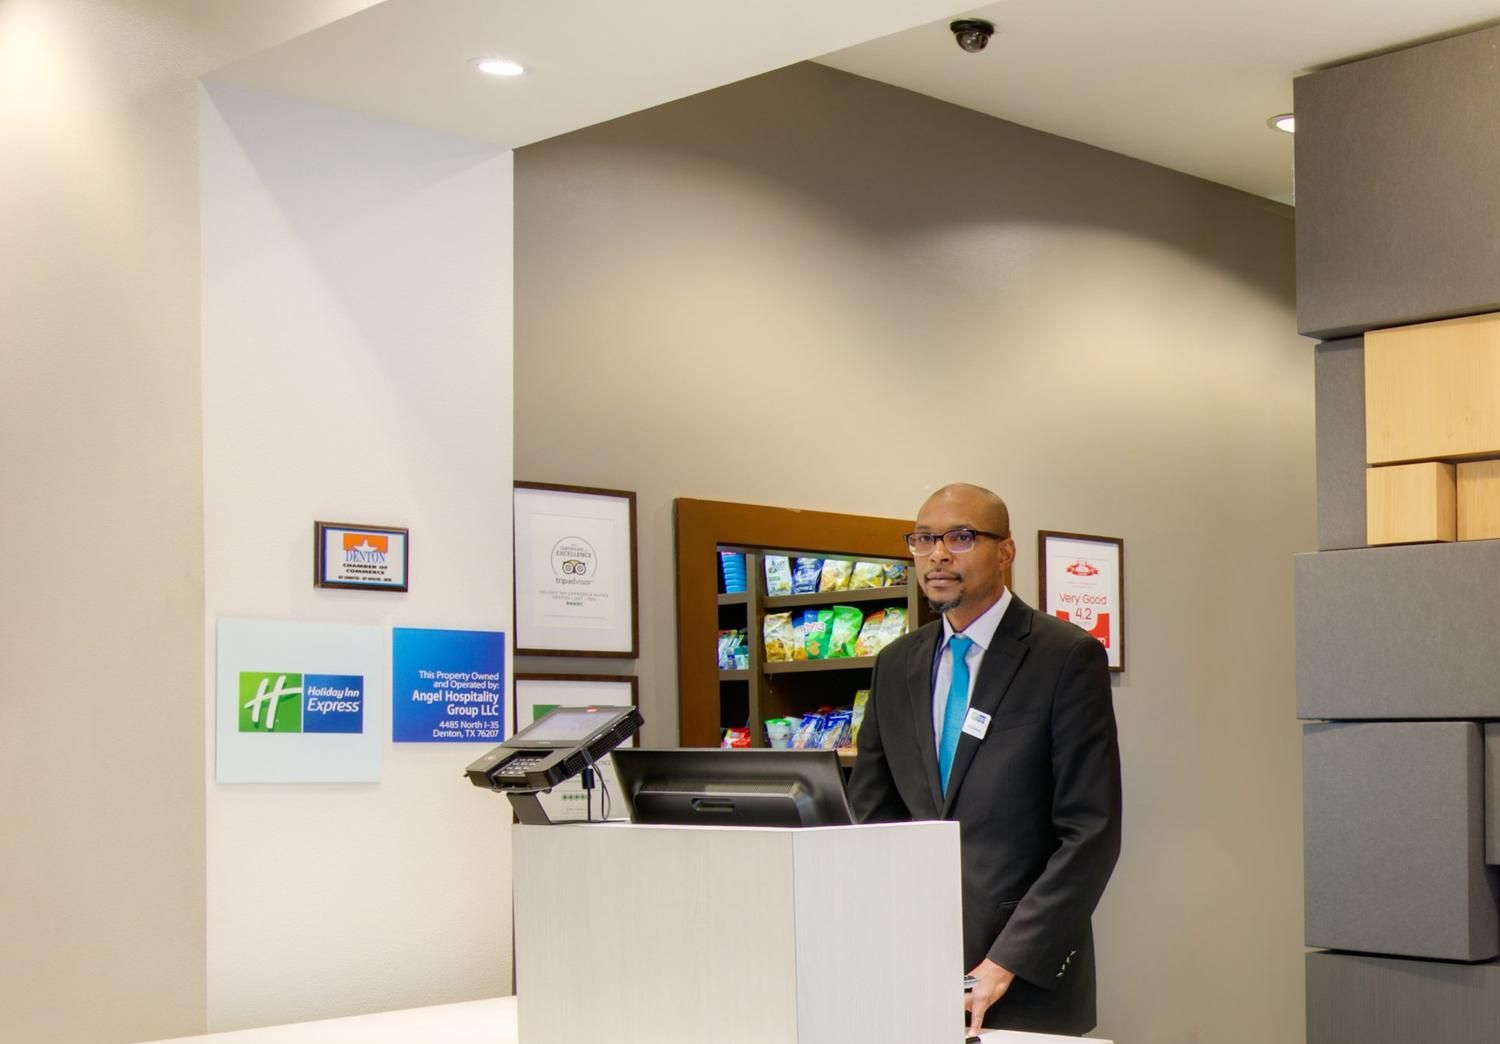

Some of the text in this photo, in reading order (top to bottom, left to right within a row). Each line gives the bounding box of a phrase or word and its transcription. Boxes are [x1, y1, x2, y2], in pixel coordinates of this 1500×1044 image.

[344, 550, 386, 564] DENTON
[555, 577, 591, 586] tripadvisor
[1059, 592, 1107, 605] Very Good
[1075, 607, 1093, 620] 4.2
[418, 670, 499, 681] This Property Owned
[307, 685, 360, 698] Holiday Inn
[433, 680, 500, 691] and Operated by:
[412, 689, 499, 704] Angel Hospitality
[307, 698, 360, 715] Express
[447, 704, 499, 718] Group LLC
[439, 721, 499, 729] 4485 North I-35
[432, 729, 463, 738] Denton,
[477, 730, 499, 738] 76207
